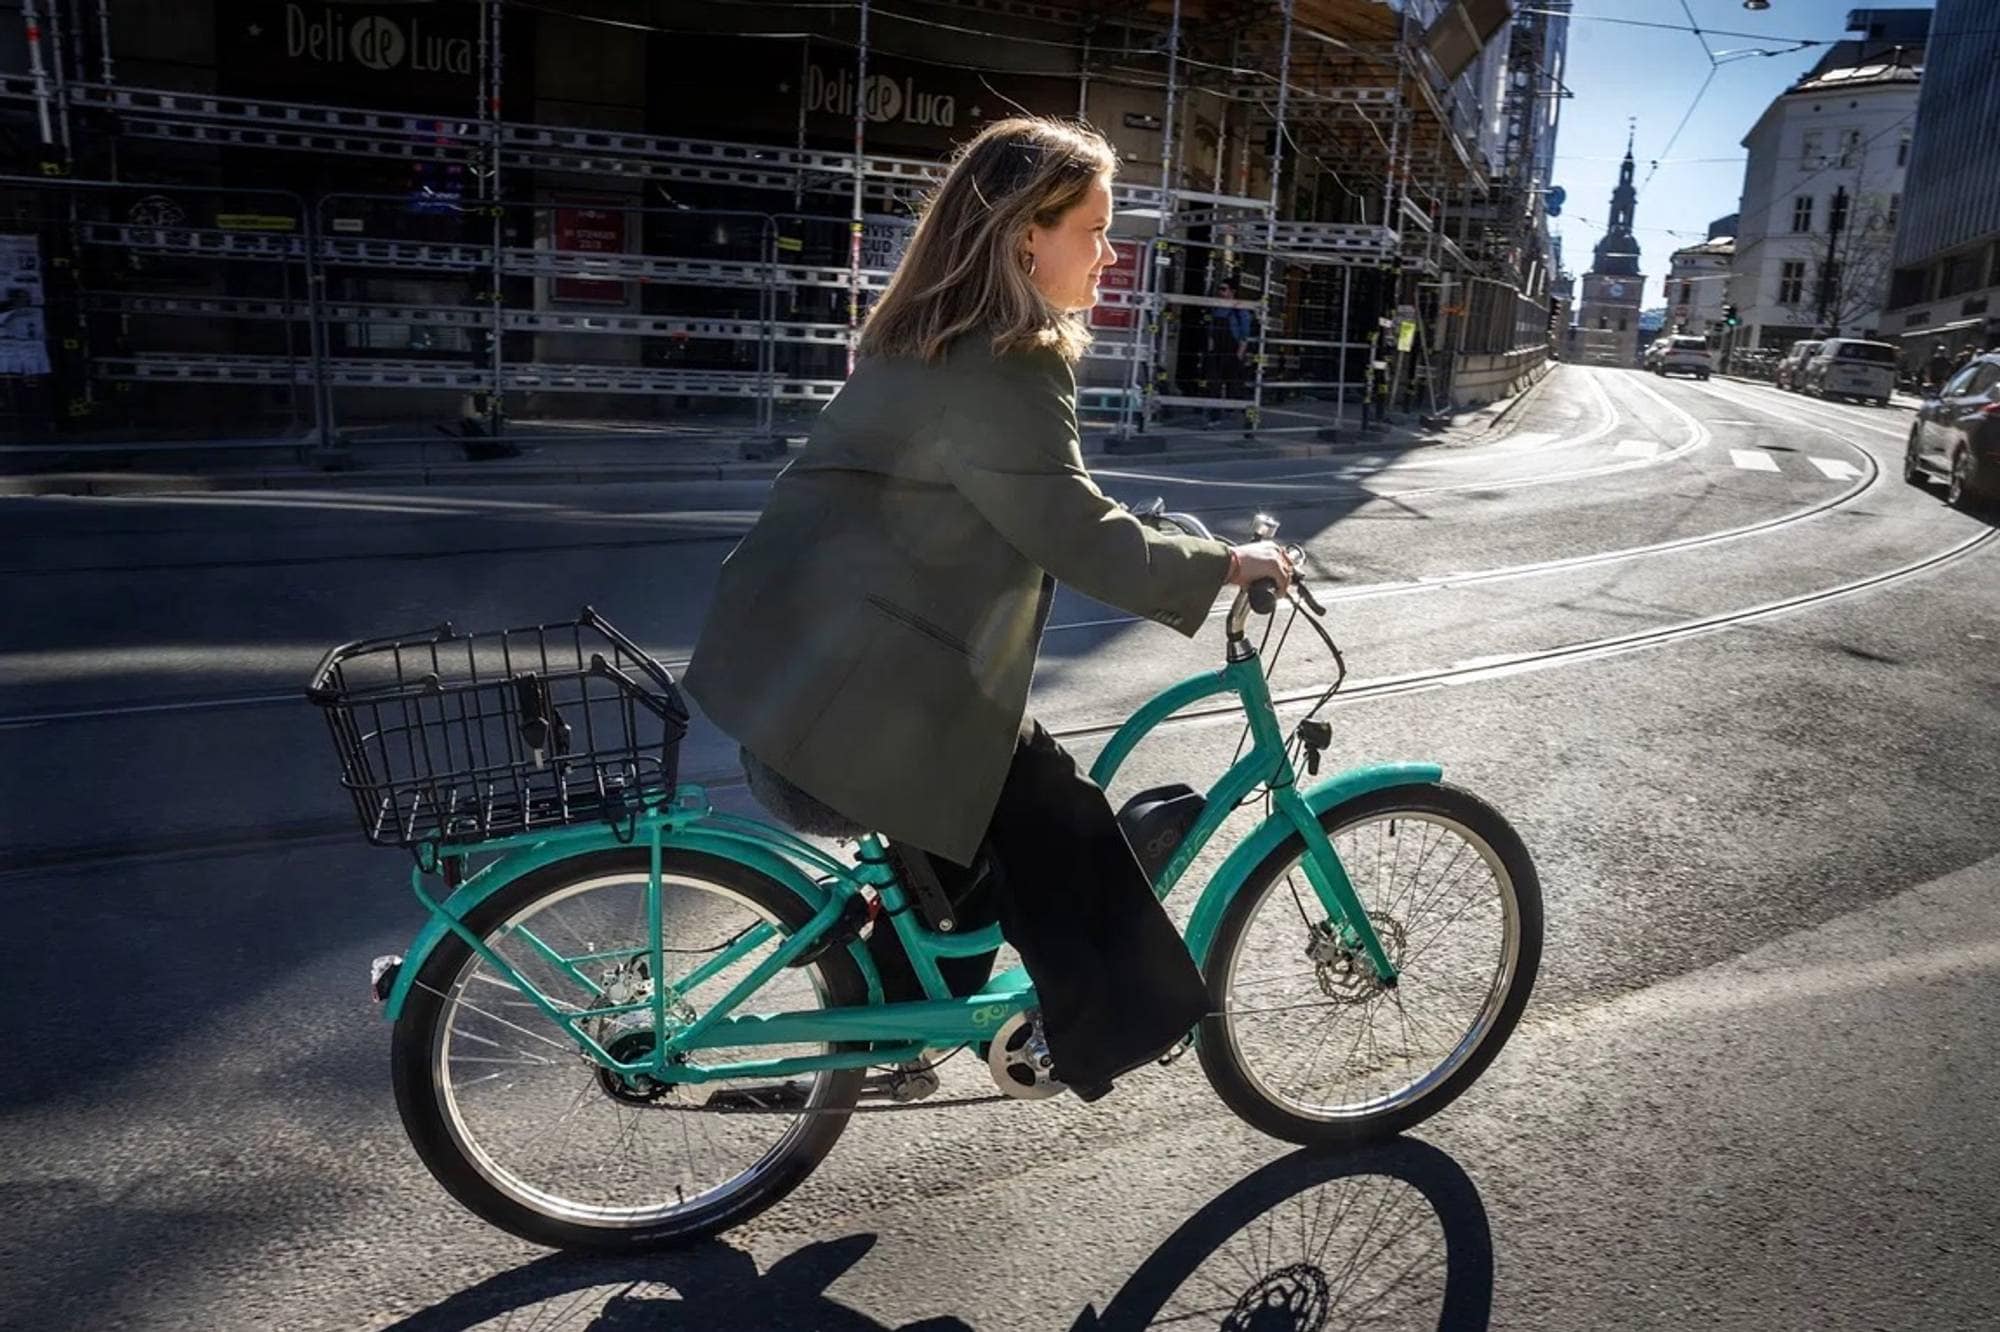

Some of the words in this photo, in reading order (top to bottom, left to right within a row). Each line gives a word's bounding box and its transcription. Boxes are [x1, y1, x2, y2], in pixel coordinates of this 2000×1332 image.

[285, 2, 345, 64] Deli
[410, 16, 472, 75] Luca
[903, 76, 956, 128] Luca
